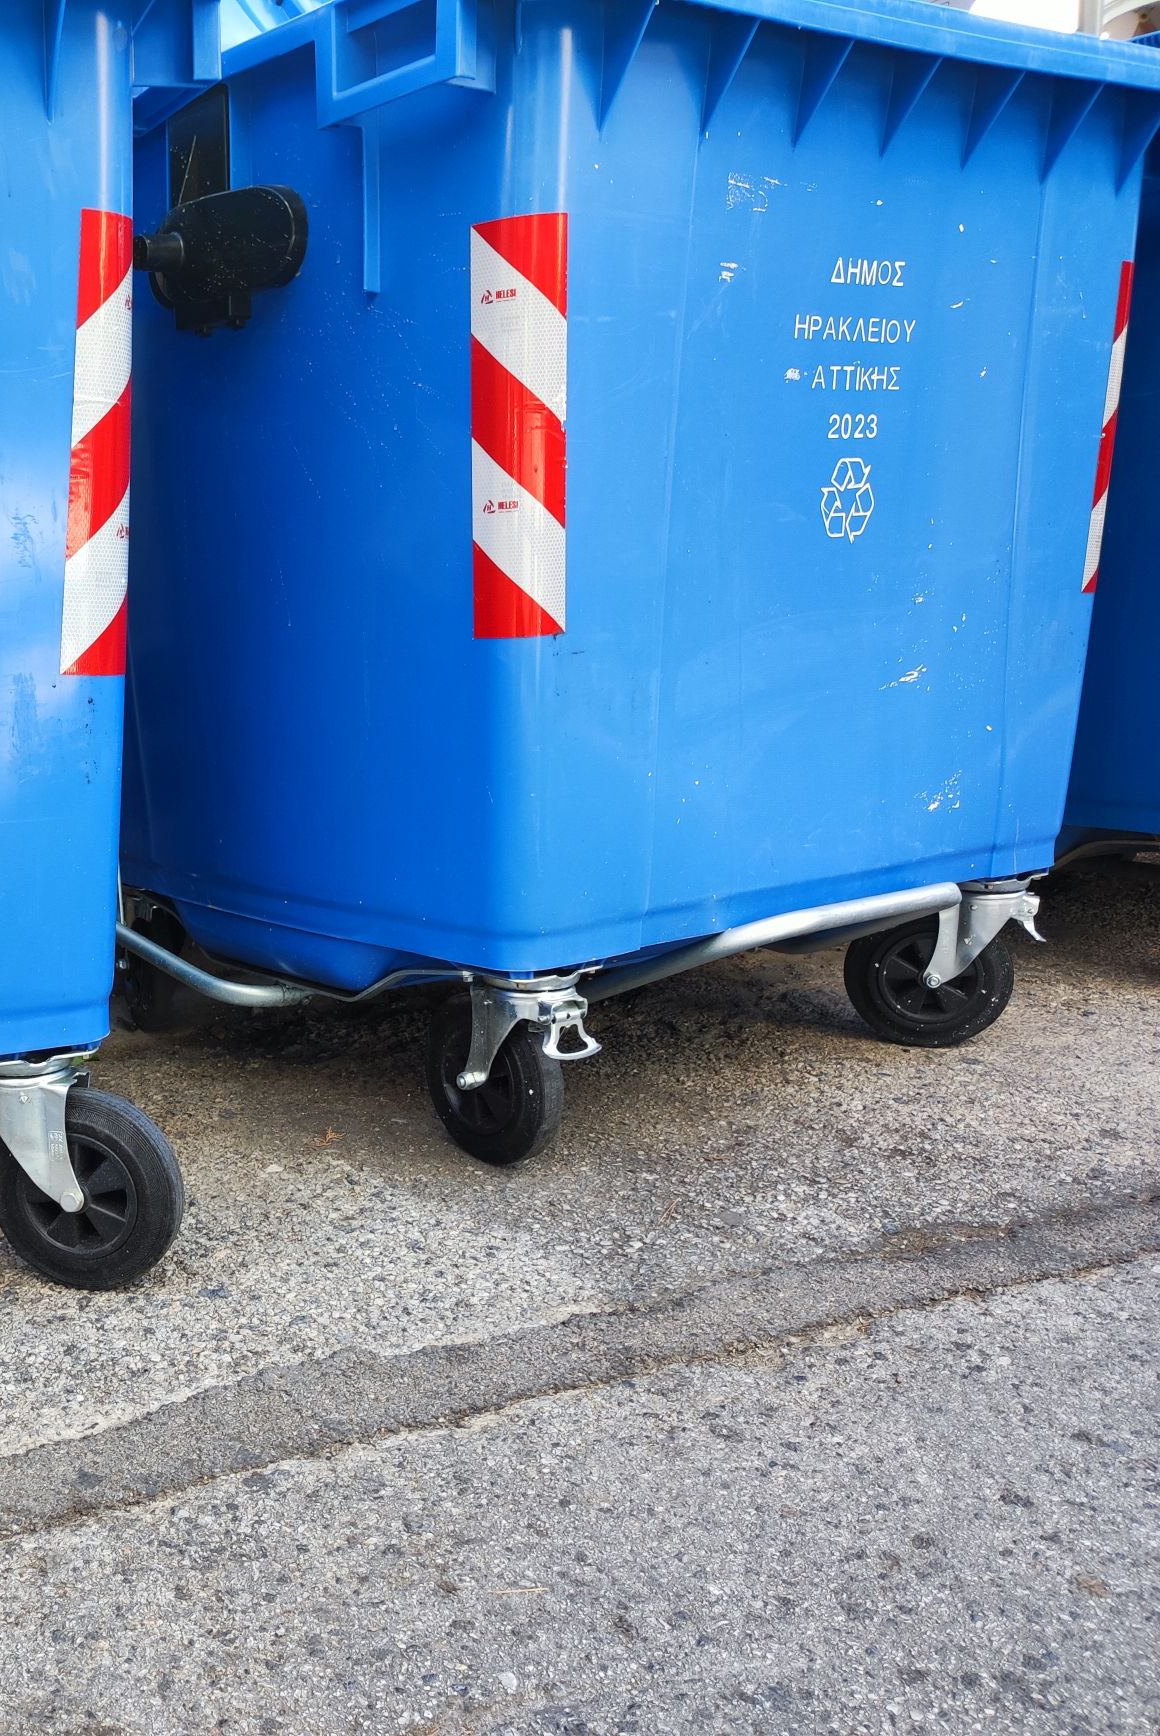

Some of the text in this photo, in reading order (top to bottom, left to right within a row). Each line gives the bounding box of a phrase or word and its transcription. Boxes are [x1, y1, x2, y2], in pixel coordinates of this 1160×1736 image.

[830, 257, 906, 287] ΔΗΜΟΣ
[794, 314, 916, 344] ΗΡΑΚΛΕΙΟΥ
[811, 365, 901, 391] ΑΤΤΙΚΗΣ
[827, 413, 878, 440] 2023
